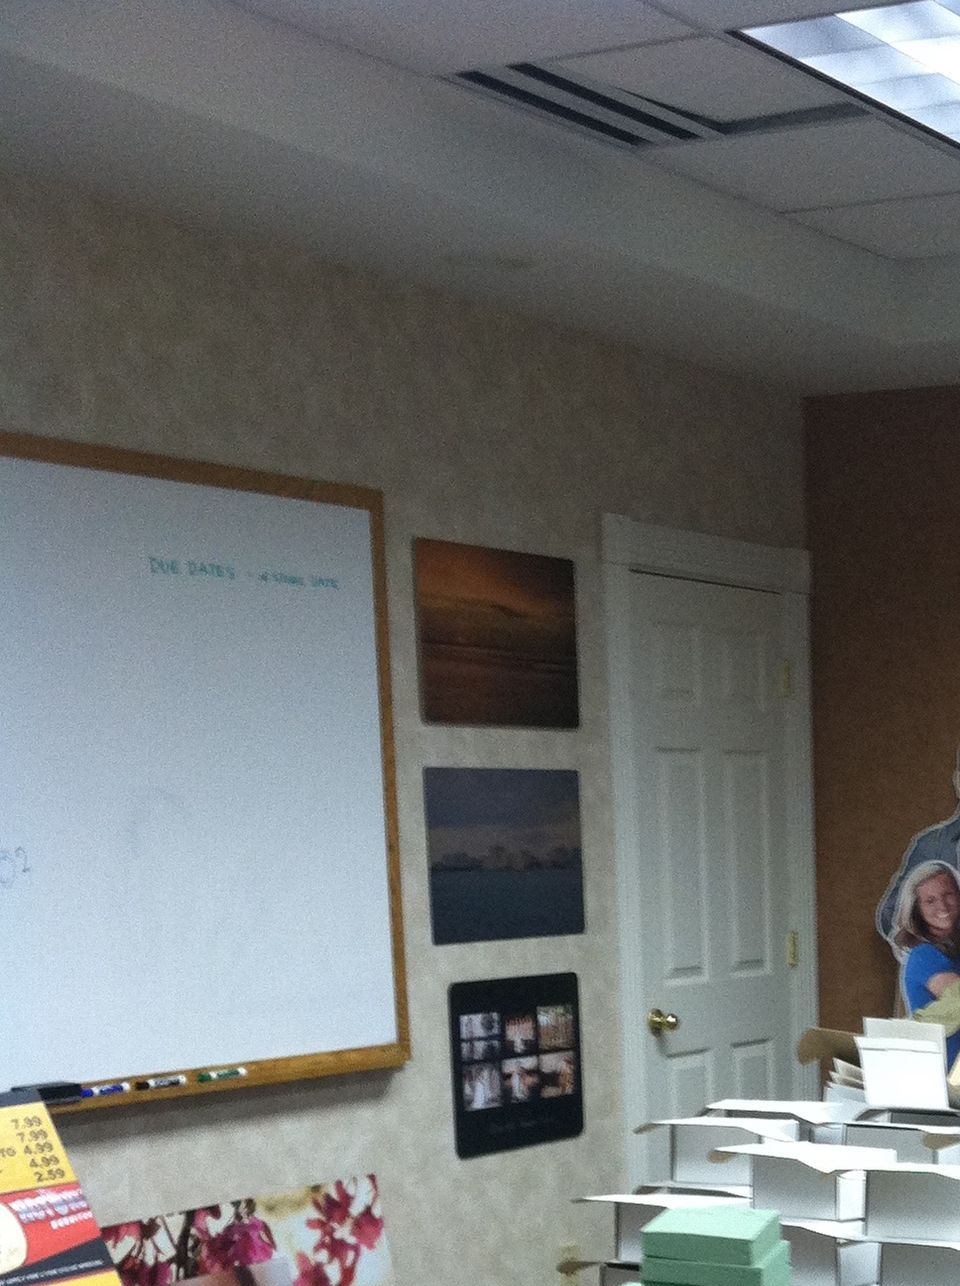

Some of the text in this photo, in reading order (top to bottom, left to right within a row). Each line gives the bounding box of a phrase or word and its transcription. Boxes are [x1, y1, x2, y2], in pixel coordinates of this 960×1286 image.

[148, 556, 179, 575] DUE
[187, 560, 236, 580] DATES
[12, 1116, 42, 1129] 7.99
[17, 1129, 48, 1143] 7.99
[23, 1141, 54, 1155] 4.99
[29, 1154, 60, 1168] 4.99
[34, 1167, 66, 1182] 2.59
